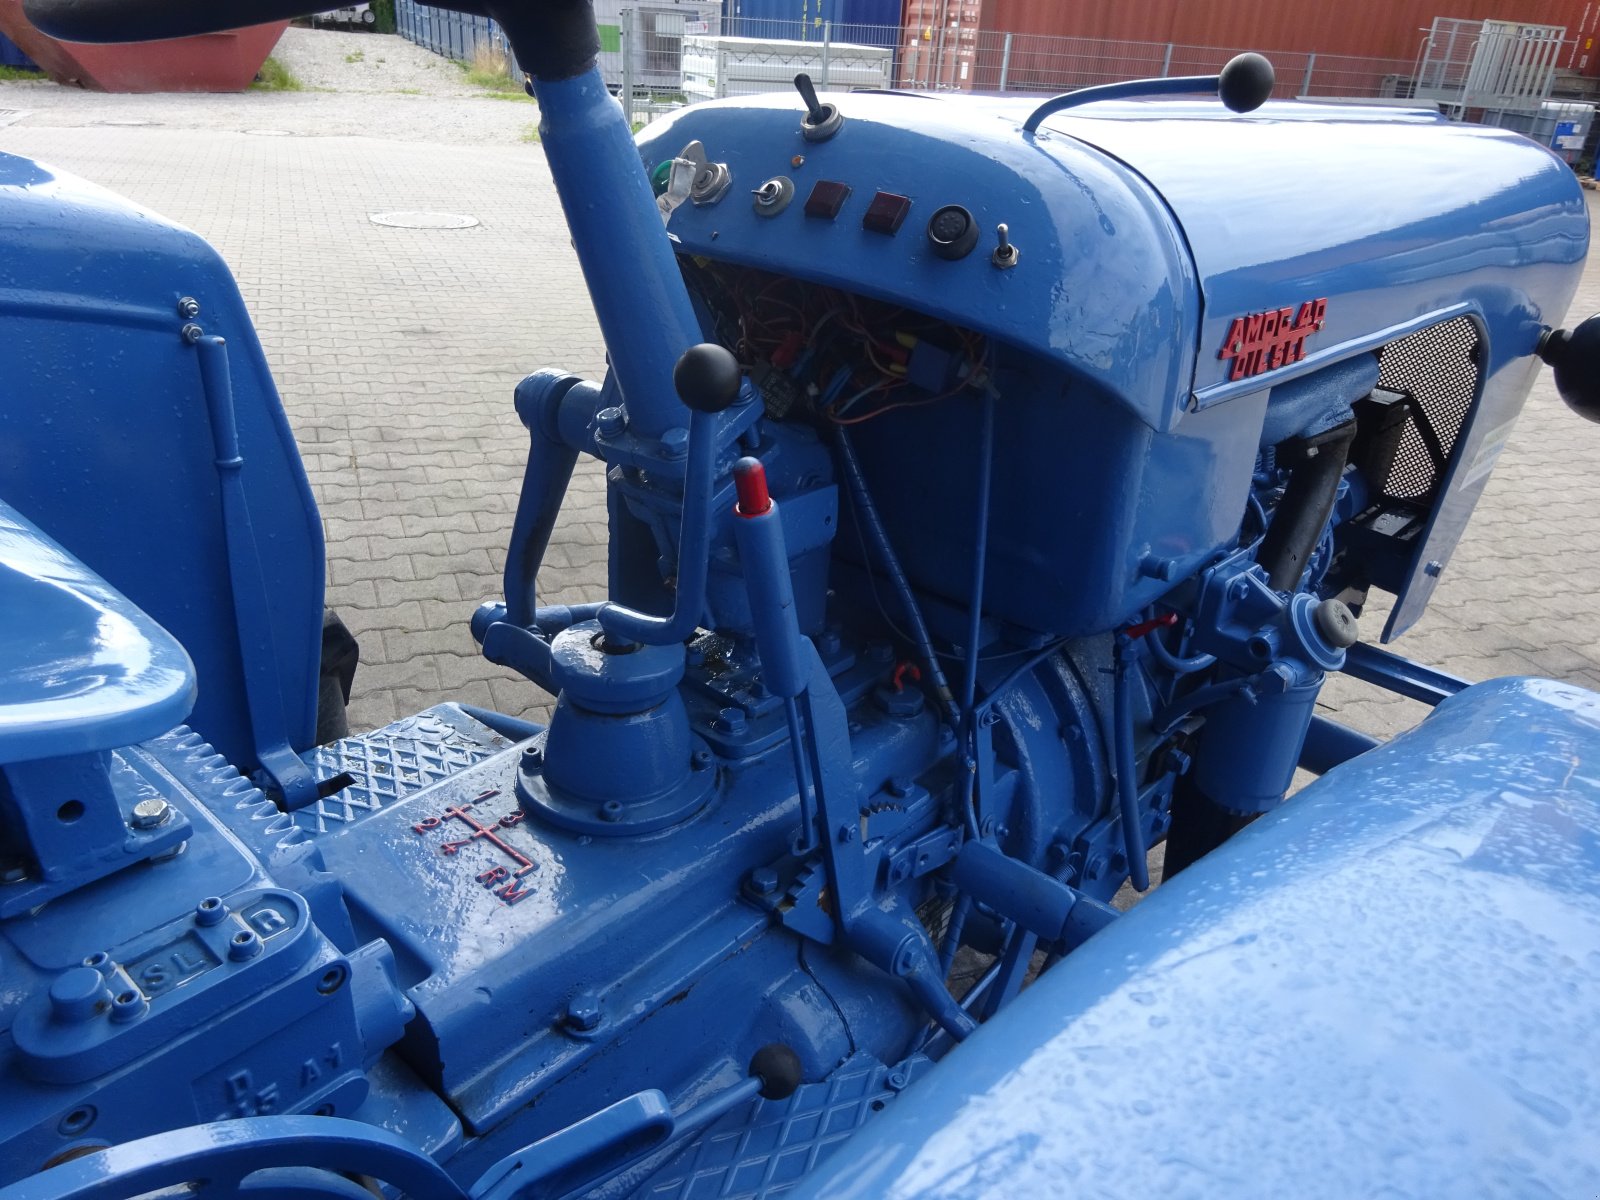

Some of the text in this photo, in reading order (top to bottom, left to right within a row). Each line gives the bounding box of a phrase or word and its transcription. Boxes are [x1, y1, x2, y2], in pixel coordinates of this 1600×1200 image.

[1230, 337, 1307, 382] DIESEL
[411, 816, 442, 836] 2
[440, 839, 473, 857] 4
[249, 908, 286, 933] R
